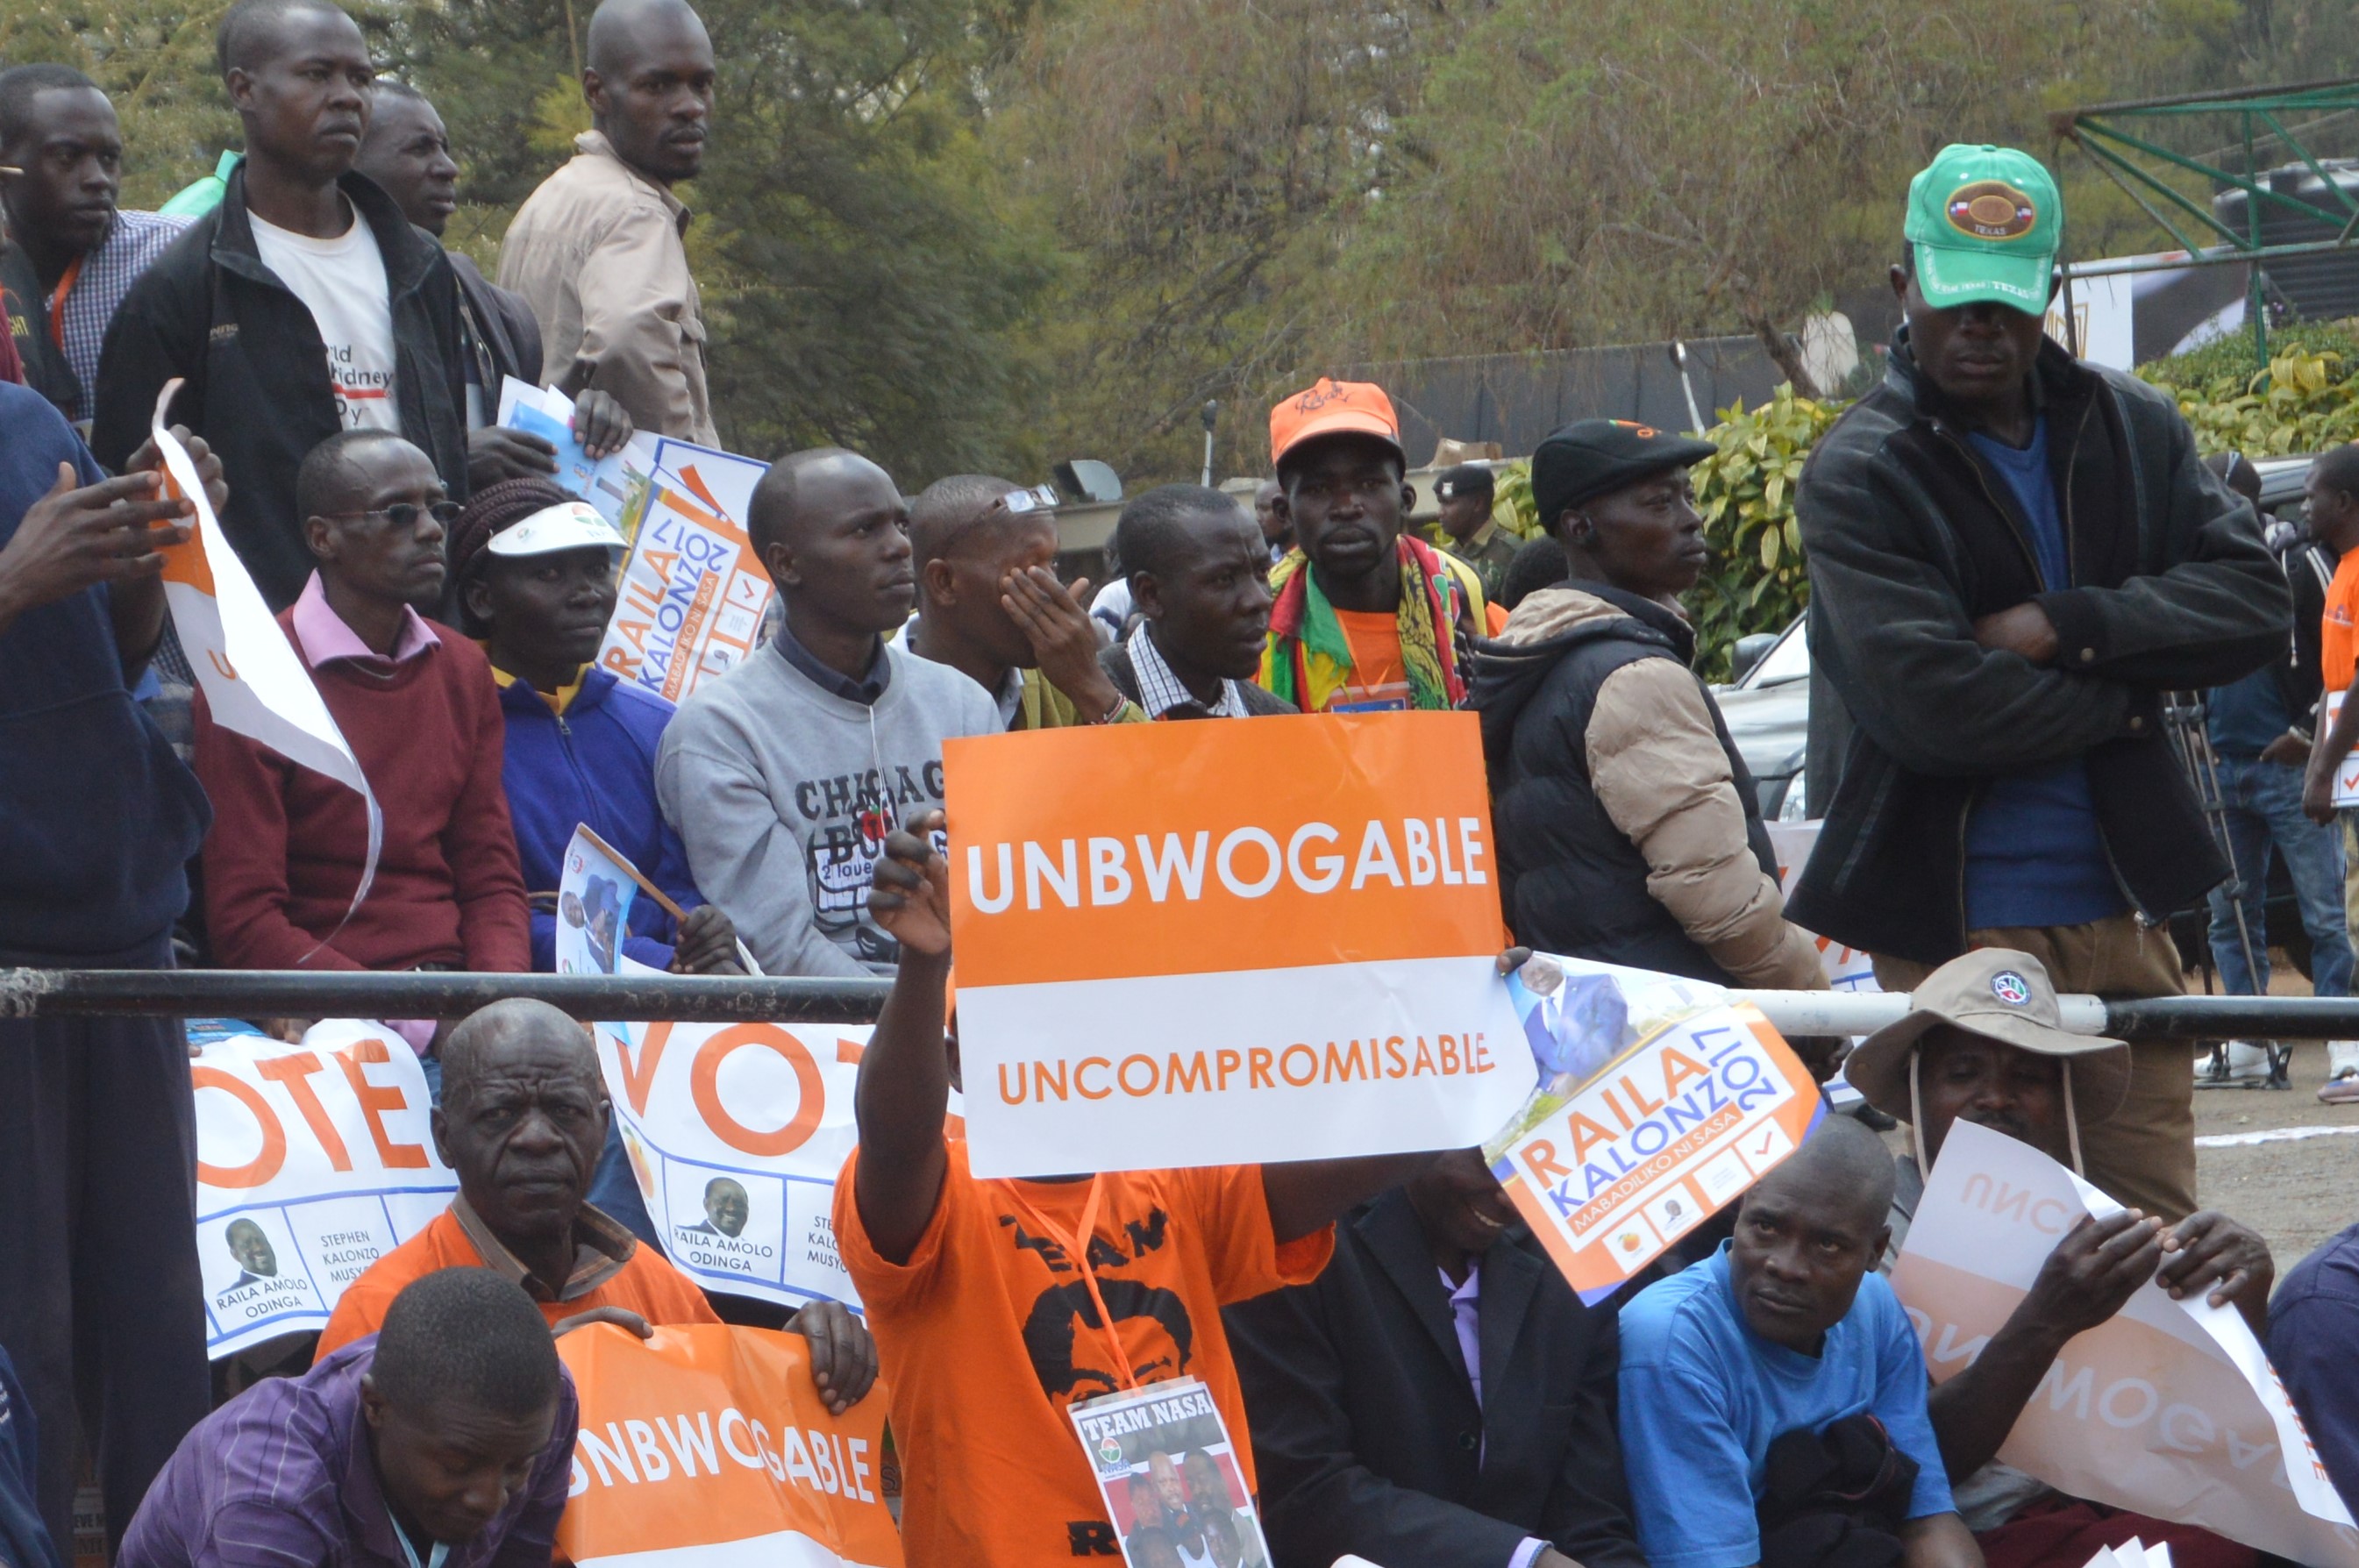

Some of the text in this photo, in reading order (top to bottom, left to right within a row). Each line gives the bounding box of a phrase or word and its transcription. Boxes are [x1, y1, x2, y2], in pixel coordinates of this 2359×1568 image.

[1974, 225, 2006, 235] TEXAS
[330, 345, 351, 362] ld
[335, 399, 362, 425] Dy
[602, 548, 681, 682] RAILA
[966, 816, 1487, 914] UNBWOGABLE
[998, 1032, 1496, 1105] UNCOMPROMISABLE
[1691, 1026, 1778, 1111] 2017
[1519, 1046, 1711, 1190] RAILA
[1574, 1154, 1672, 1231] MABADILIKO
[1673, 1139, 1694, 1158] NI
[1696, 1113, 1738, 1143] SASA
[321, 1230, 370, 1248] STEPHEN
[716, 1238, 773, 1258] AMOLO
[322, 1247, 380, 1266] KALONZO
[689, 1251, 752, 1272] ODINGA
[330, 1265, 369, 1283] MUSY
[216, 1278, 308, 1311] RAILA AMOLO
[246, 1295, 303, 1319] ODINGA
[1081, 1393, 1214, 1442] TEAM NASA
